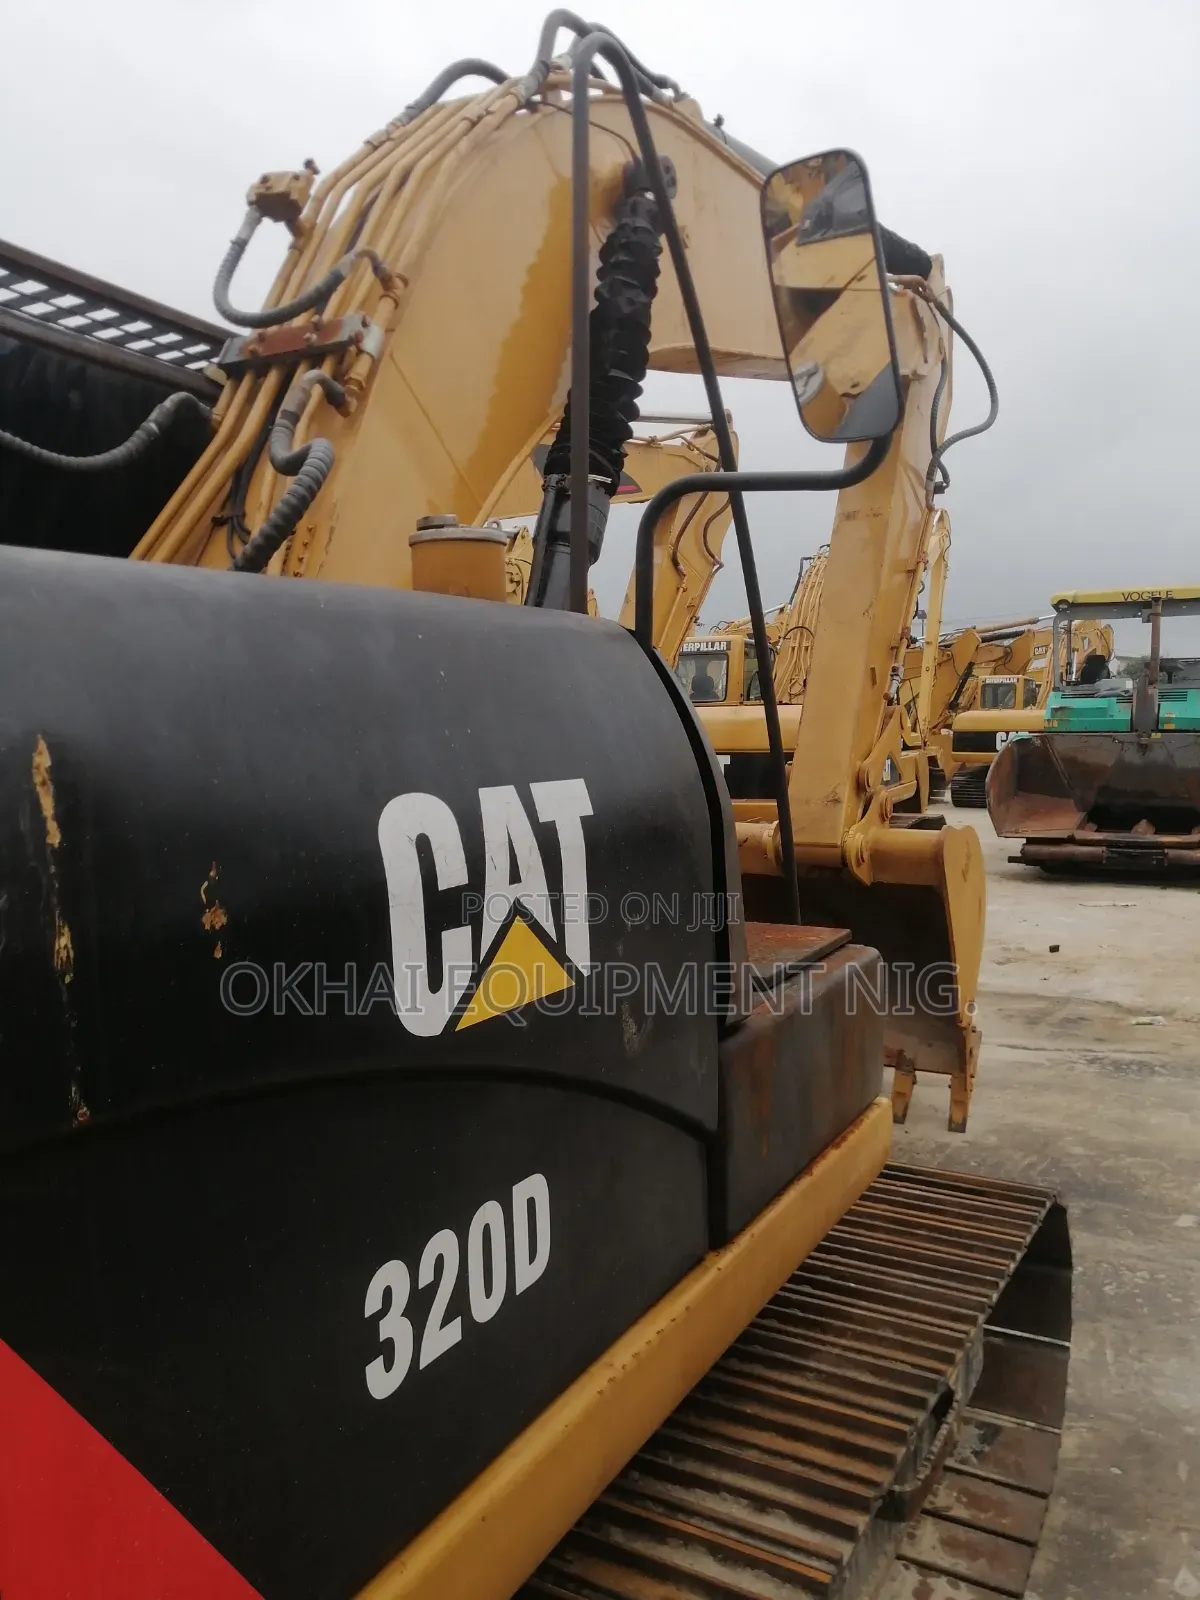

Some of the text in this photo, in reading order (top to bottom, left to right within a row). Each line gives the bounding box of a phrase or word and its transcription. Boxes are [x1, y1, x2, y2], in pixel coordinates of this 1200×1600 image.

[680, 641, 728, 652] ERPILLAR
[378, 778, 594, 1037] CAT
[364, 1173, 552, 1400] 320D
